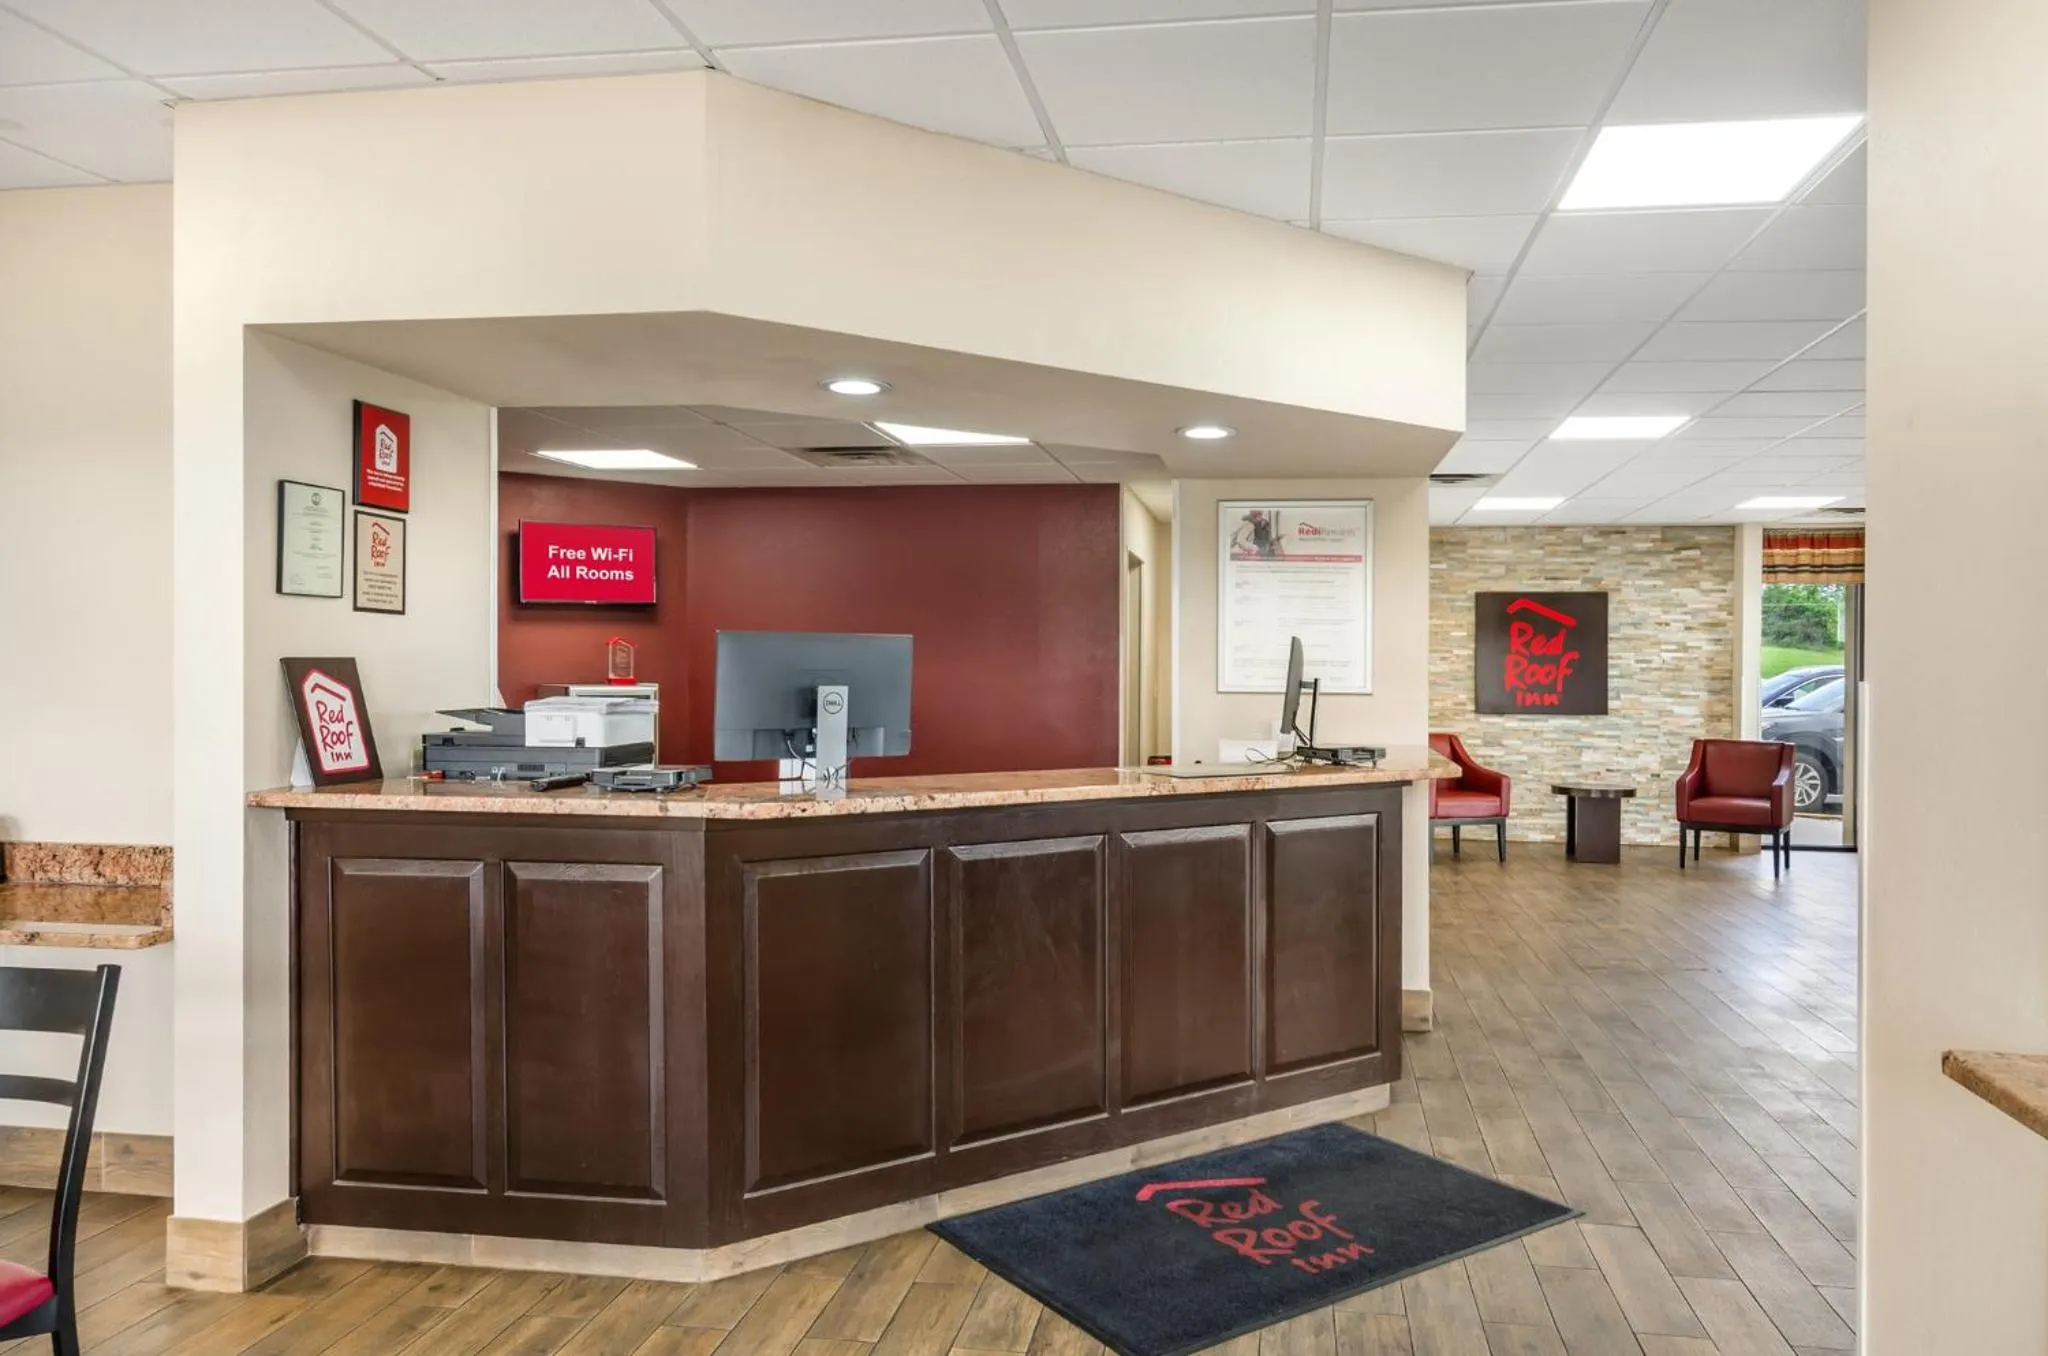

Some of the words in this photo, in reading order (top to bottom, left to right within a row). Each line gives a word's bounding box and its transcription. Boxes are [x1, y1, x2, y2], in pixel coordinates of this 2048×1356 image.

[548, 545, 586, 560] Free
[590, 547, 634, 562] Wi-Fi
[547, 564, 570, 579] All
[575, 565, 634, 581] Rooms
[1510, 621, 1567, 657] Red
[1504, 650, 1579, 693] Roof
[316, 700, 345, 725] Red
[319, 720, 354, 752] Roof
[1165, 1188, 1283, 1228] Red
[1212, 1200, 1354, 1265] Roof
